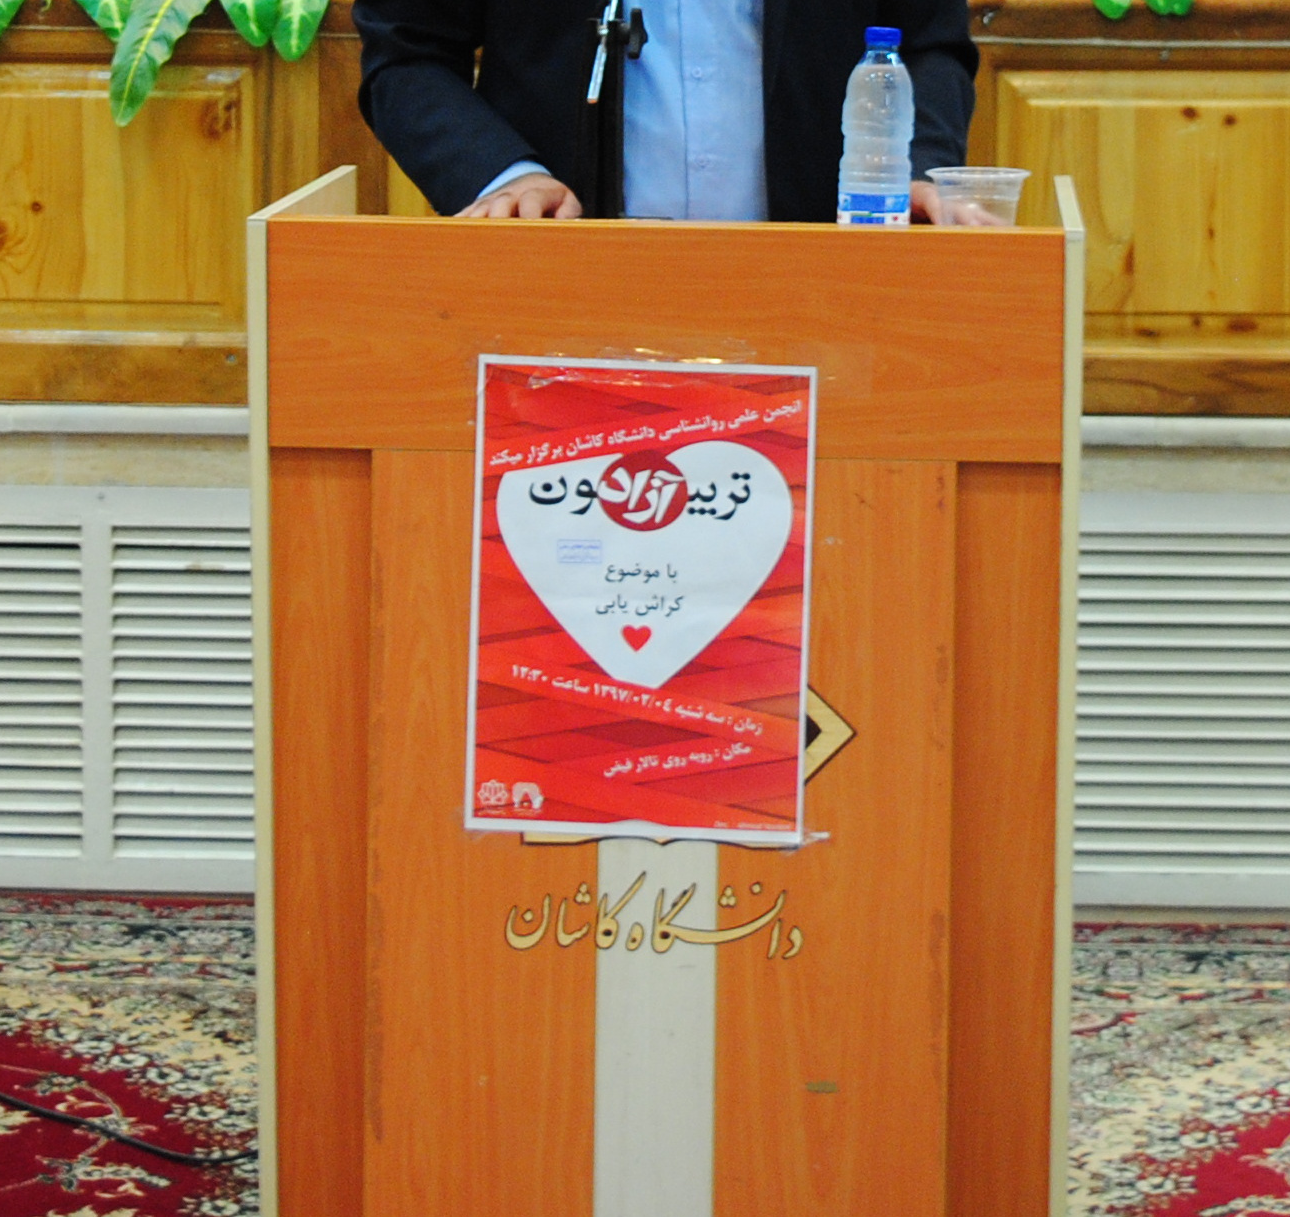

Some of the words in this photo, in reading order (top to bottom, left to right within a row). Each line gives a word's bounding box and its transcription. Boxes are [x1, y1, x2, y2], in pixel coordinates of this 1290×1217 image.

[728, 408, 759, 430] علمی
[762, 399, 802, 423] انجمن
[607, 426, 656, 445] دانشگاه
[658, 415, 726, 441] روانشناسی
[566, 433, 604, 457] کاشان
[489, 449, 524, 466] میکند
[597, 467, 685, 524] آزاد
[605, 563, 660, 583] موضوع
[666, 563, 677, 584] با
[595, 594, 628, 614] یابی
[635, 594, 684, 617] کراش
[552, 676, 590, 693] ساعت
[675, 705, 703, 719] شنبه
[705, 712, 725, 724] سه
[733, 717, 763, 736] زمان
[722, 742, 752, 761] مکان
[636, 755, 659, 773] تالار
[504, 871, 646, 951] کاشان
[626, 881, 803, 959] دانشگاه
